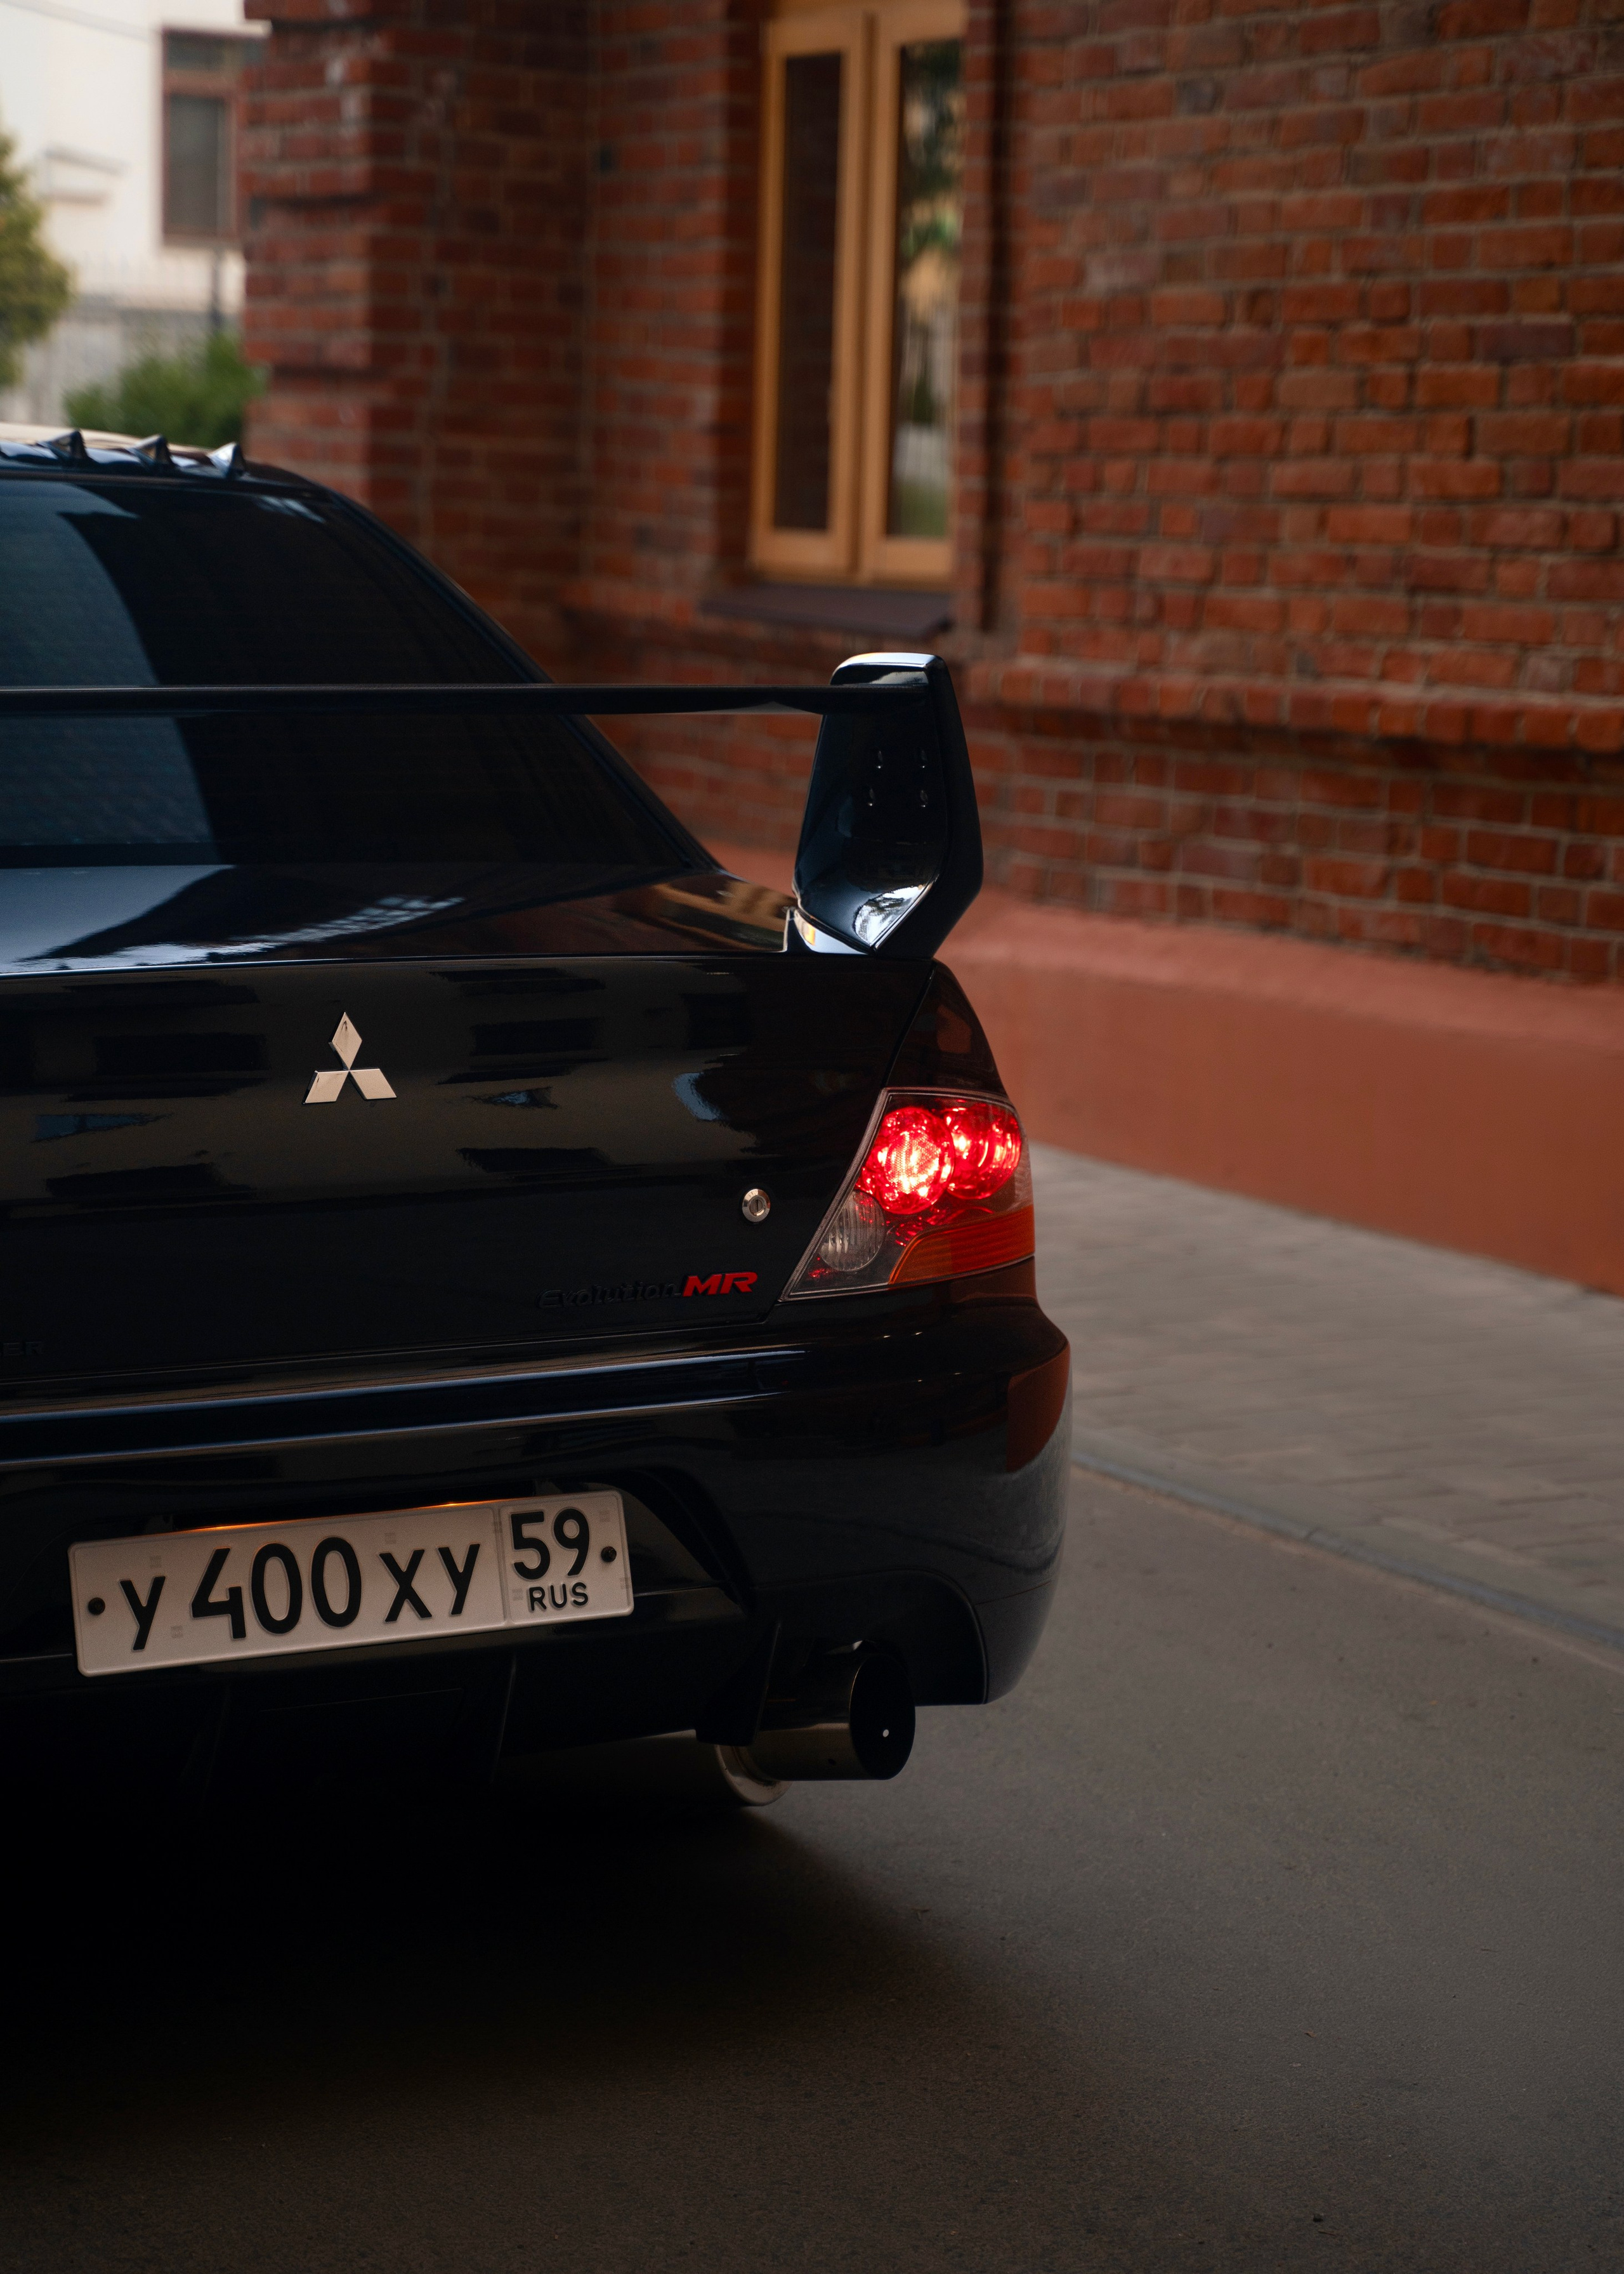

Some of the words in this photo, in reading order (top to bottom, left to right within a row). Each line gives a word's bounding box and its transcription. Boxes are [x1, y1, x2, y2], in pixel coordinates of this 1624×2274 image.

[536, 1282, 682, 1309] Evolution
[681, 1272, 759, 1298] MR
[510, 1508, 591, 1581] 59
[530, 1581, 589, 1612] RUS
